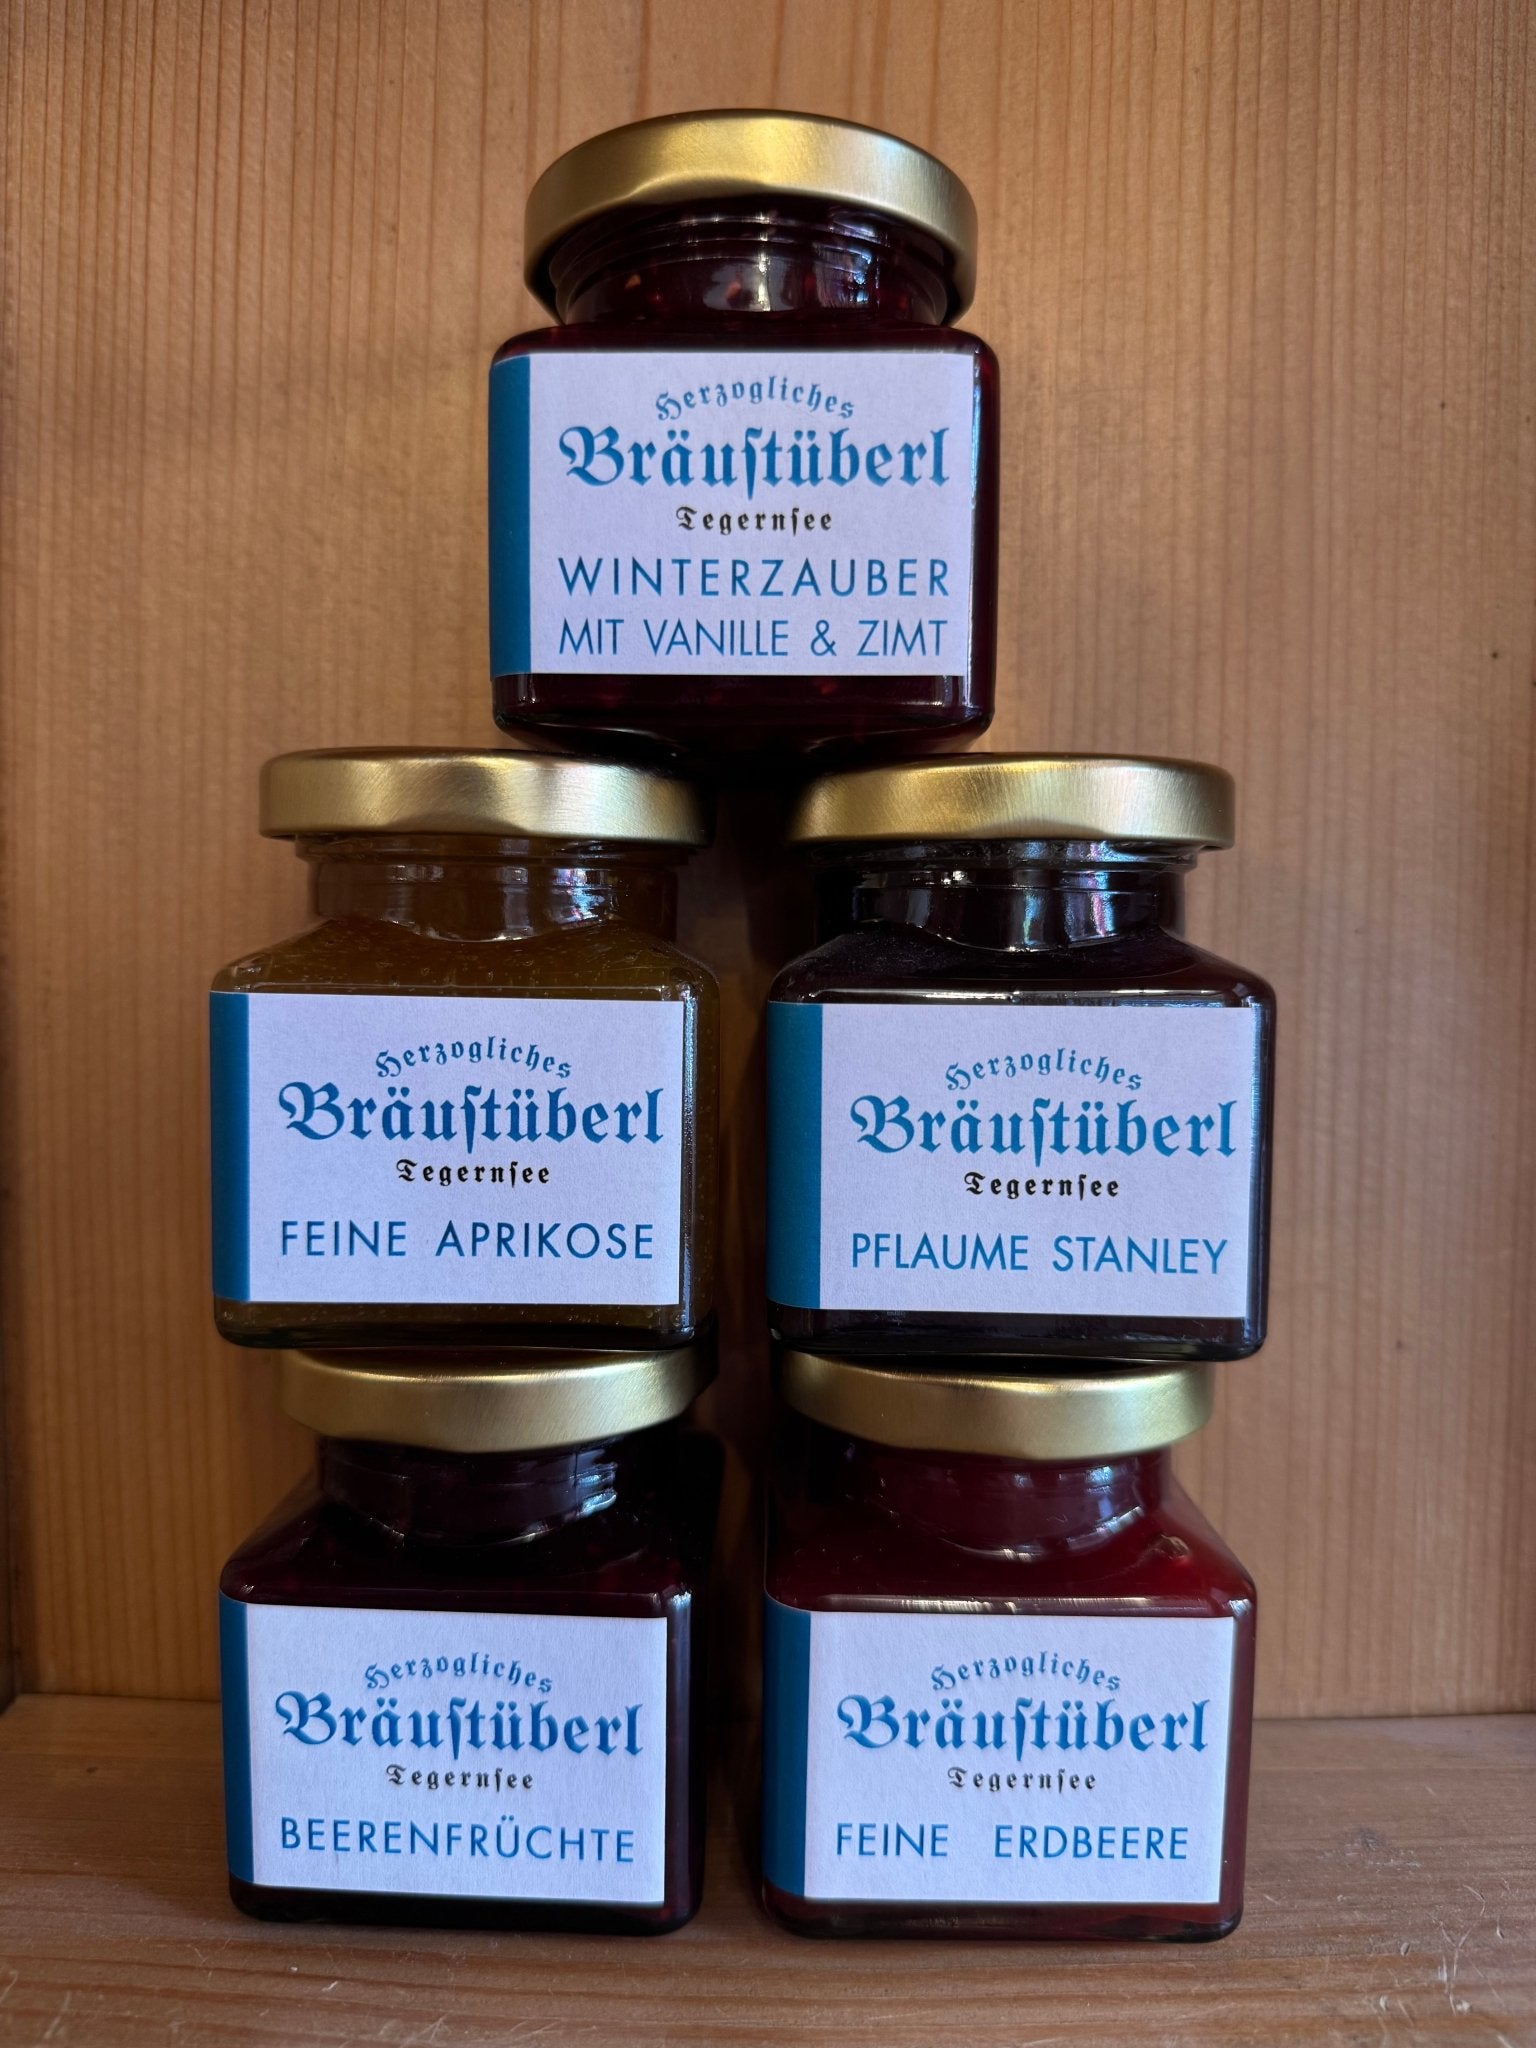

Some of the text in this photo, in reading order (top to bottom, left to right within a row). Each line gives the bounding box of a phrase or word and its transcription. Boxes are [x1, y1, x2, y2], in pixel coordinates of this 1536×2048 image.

[655, 375, 854, 421] Herzogliches
[557, 555, 949, 598] WINTERZAUBER
[558, 617, 948, 657] MIT VANILLE & ZIMT
[374, 1035, 572, 1079] Herzogliches
[945, 1047, 1142, 1091] Herzogliches
[281, 1219, 654, 1260] FEINE APRIKOSE
[851, 1232, 1228, 1275] PFLAUME STANLEY
[364, 1652, 553, 1695] Herzogliches
[930, 1651, 1121, 1692] Herzogliches
[280, 1814, 634, 1864] BEERENFRÜCHTE
[836, 1822, 1189, 1861] FEINE ERDBEERE
